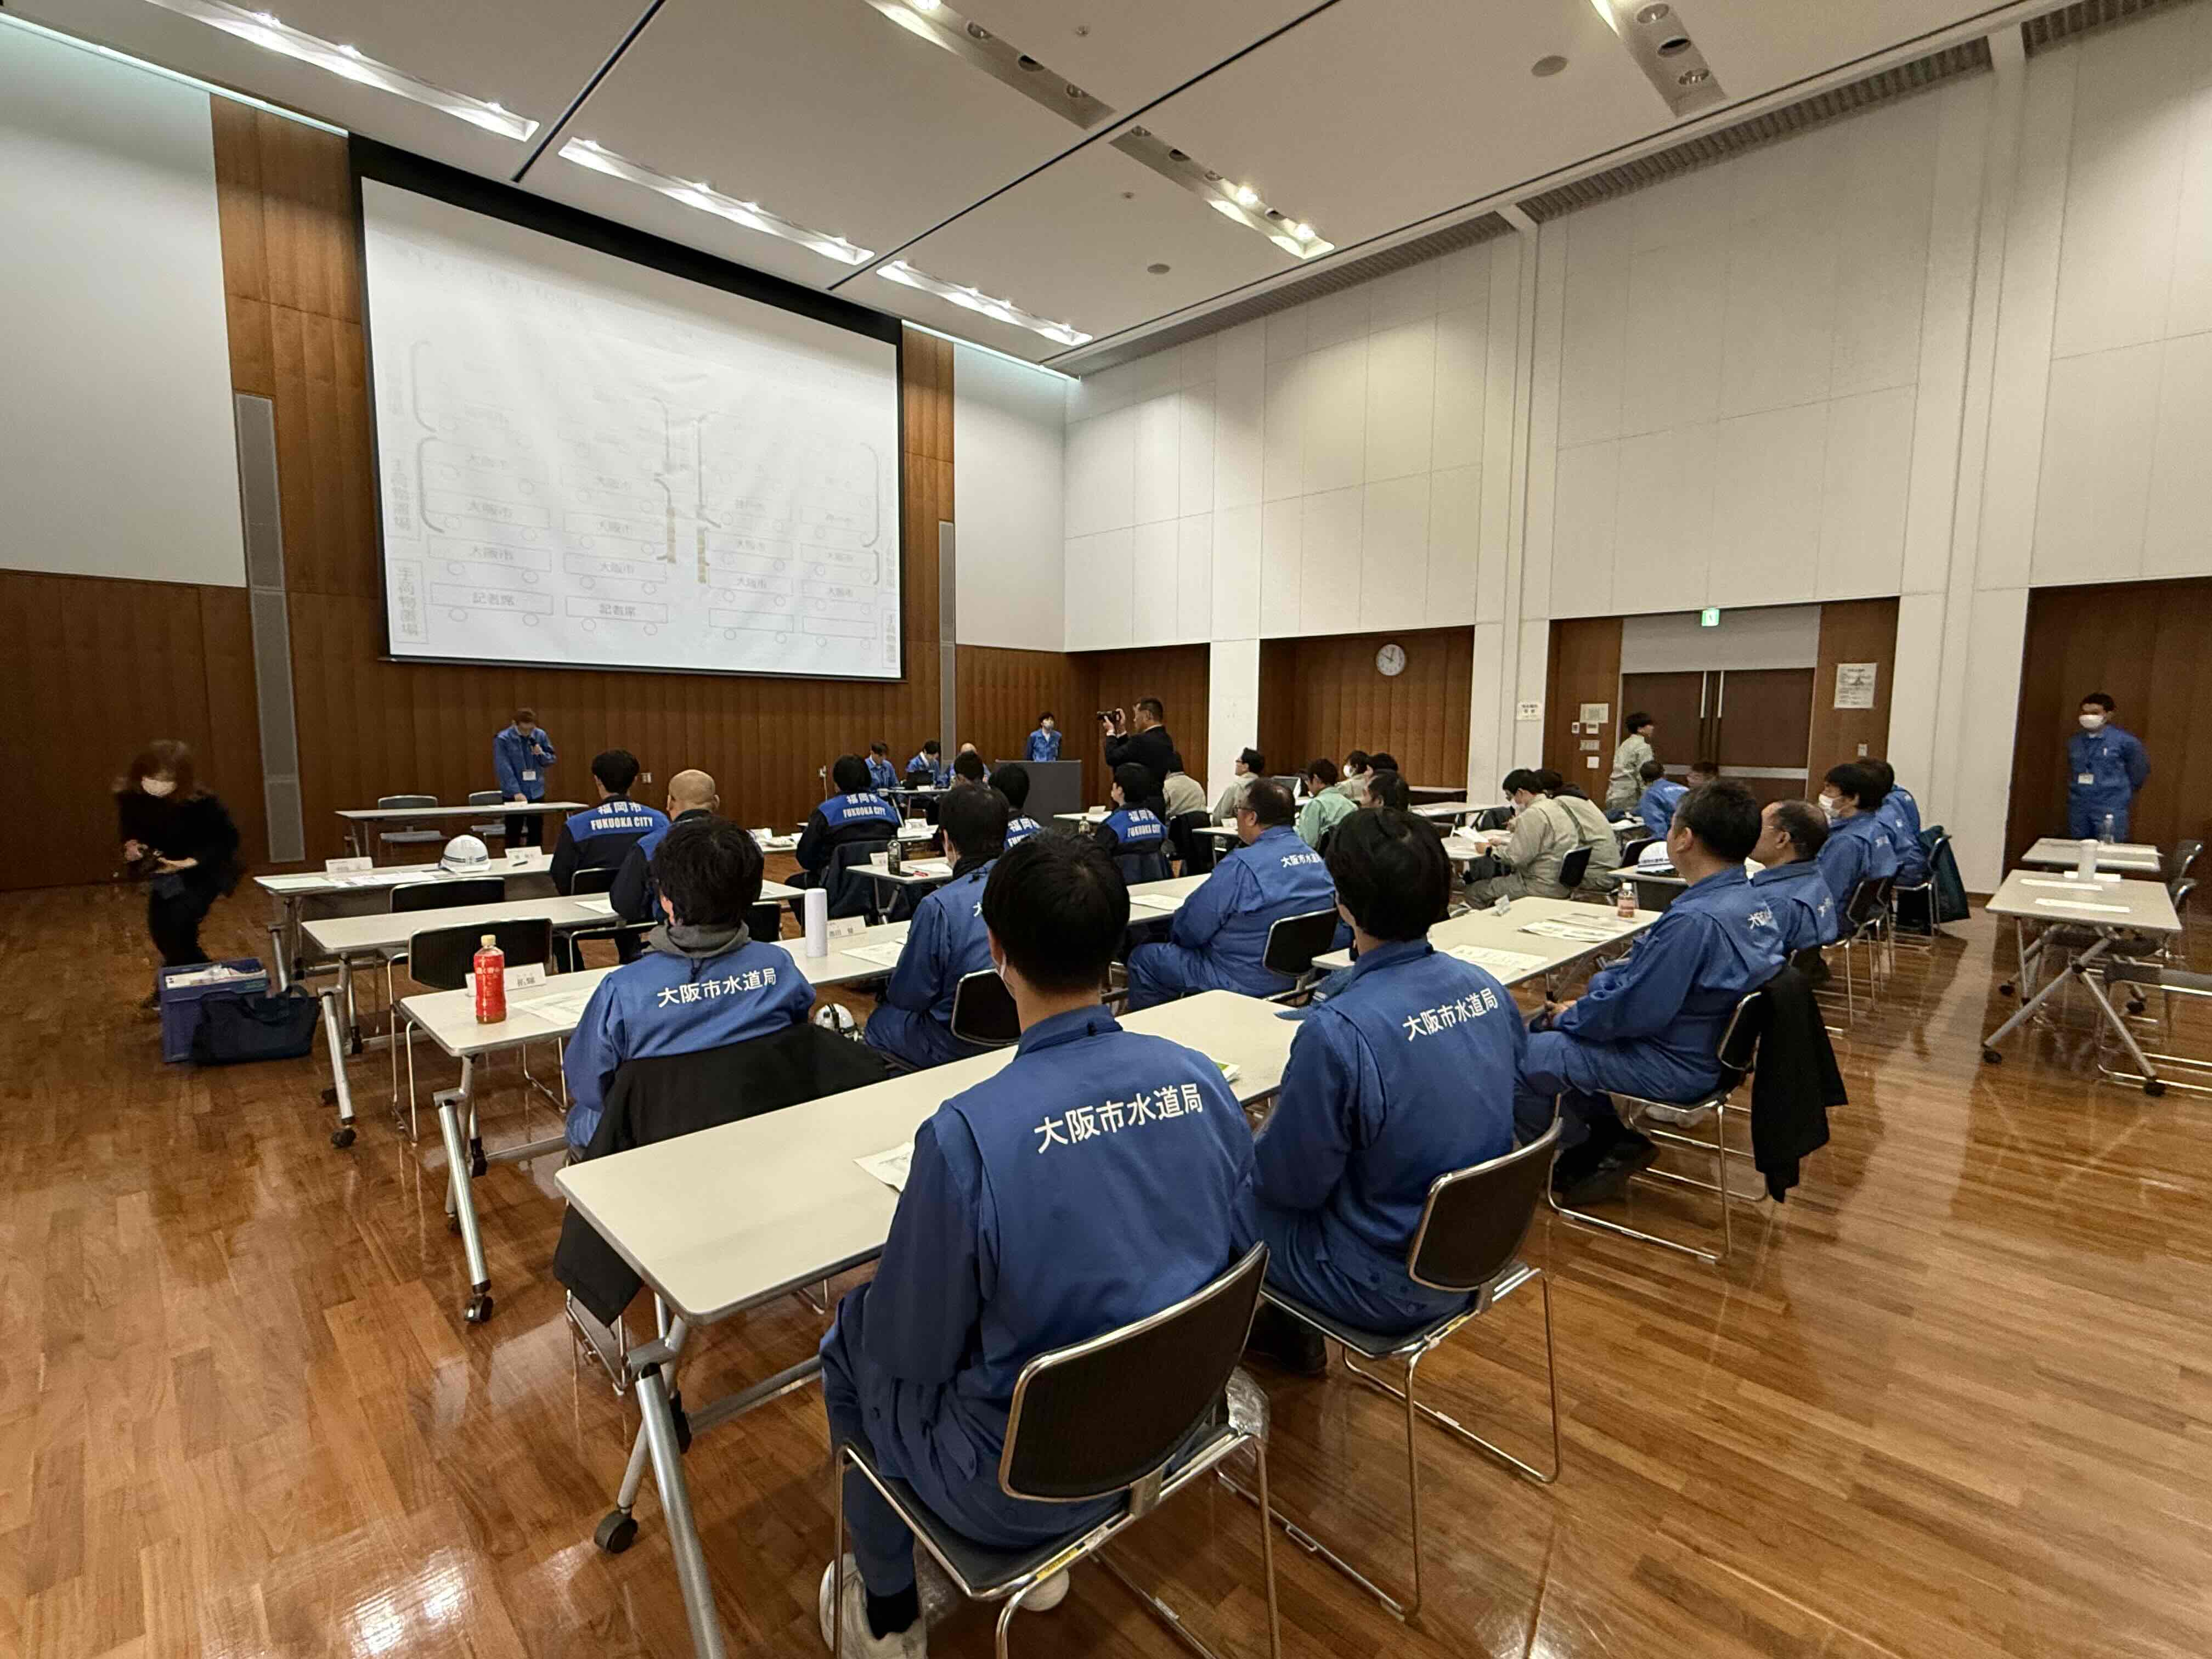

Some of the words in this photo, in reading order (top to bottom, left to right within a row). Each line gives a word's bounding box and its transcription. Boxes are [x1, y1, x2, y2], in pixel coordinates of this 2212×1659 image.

[597, 801, 642, 815] 福岡市
[843, 806, 873, 819] FUKUOKA
[591, 817, 633, 830] FUKUOKA
[634, 816, 653, 827] CITY
[657, 967, 777, 1008] 大阪市水道局
[1402, 987, 1499, 1042] 大阪市水道局
[1034, 1082, 1204, 1154] 大阪市水道局
